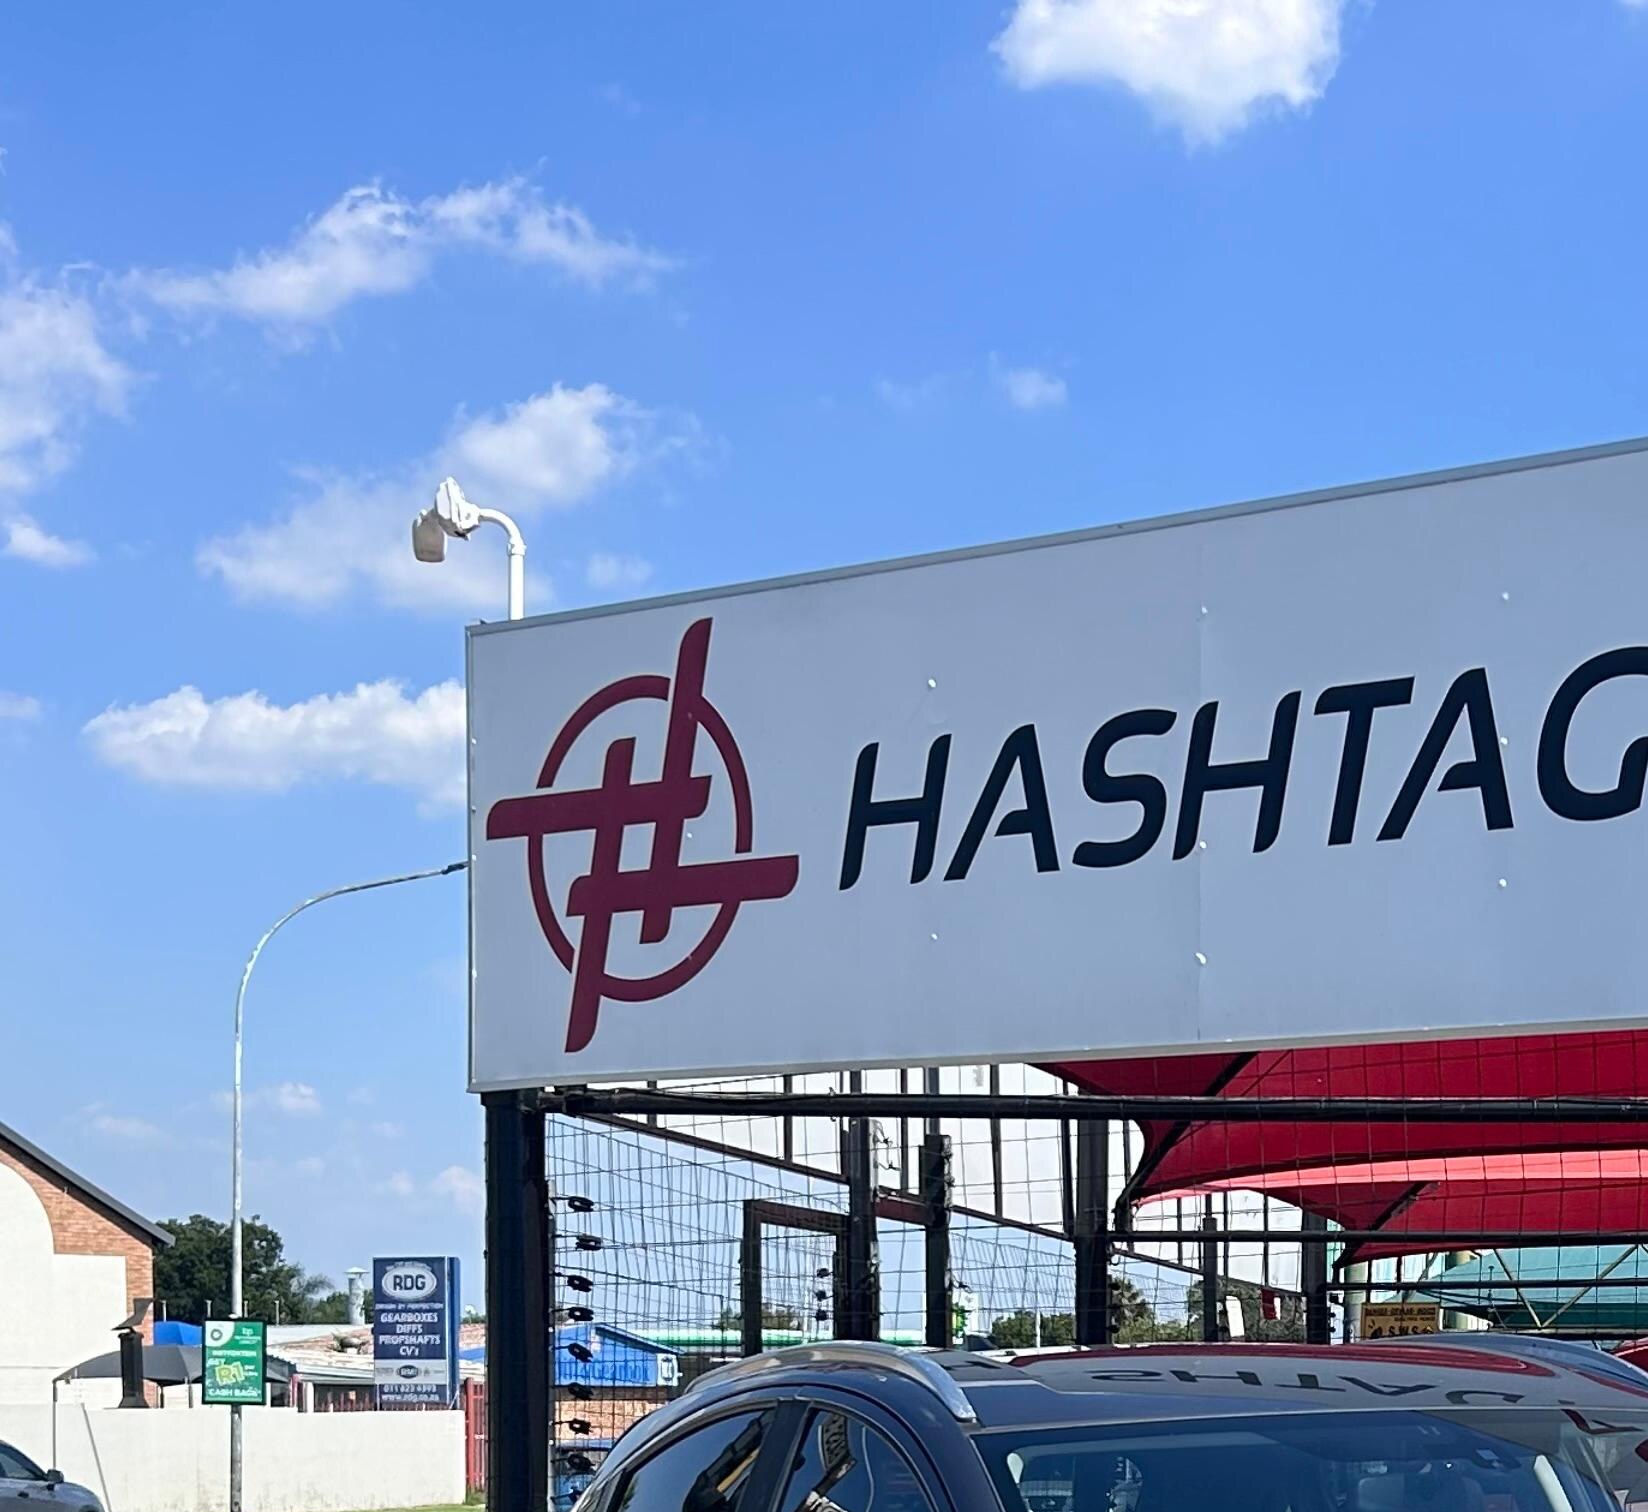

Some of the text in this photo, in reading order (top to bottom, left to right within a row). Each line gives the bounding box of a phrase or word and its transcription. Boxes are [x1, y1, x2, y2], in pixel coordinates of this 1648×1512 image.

[393, 1274, 426, 1291] RDG
[380, 1312, 438, 1323] GEARBOXES
[396, 1323, 423, 1334] DIFFS
[379, 1334, 441, 1345] PROPSHAFTS
